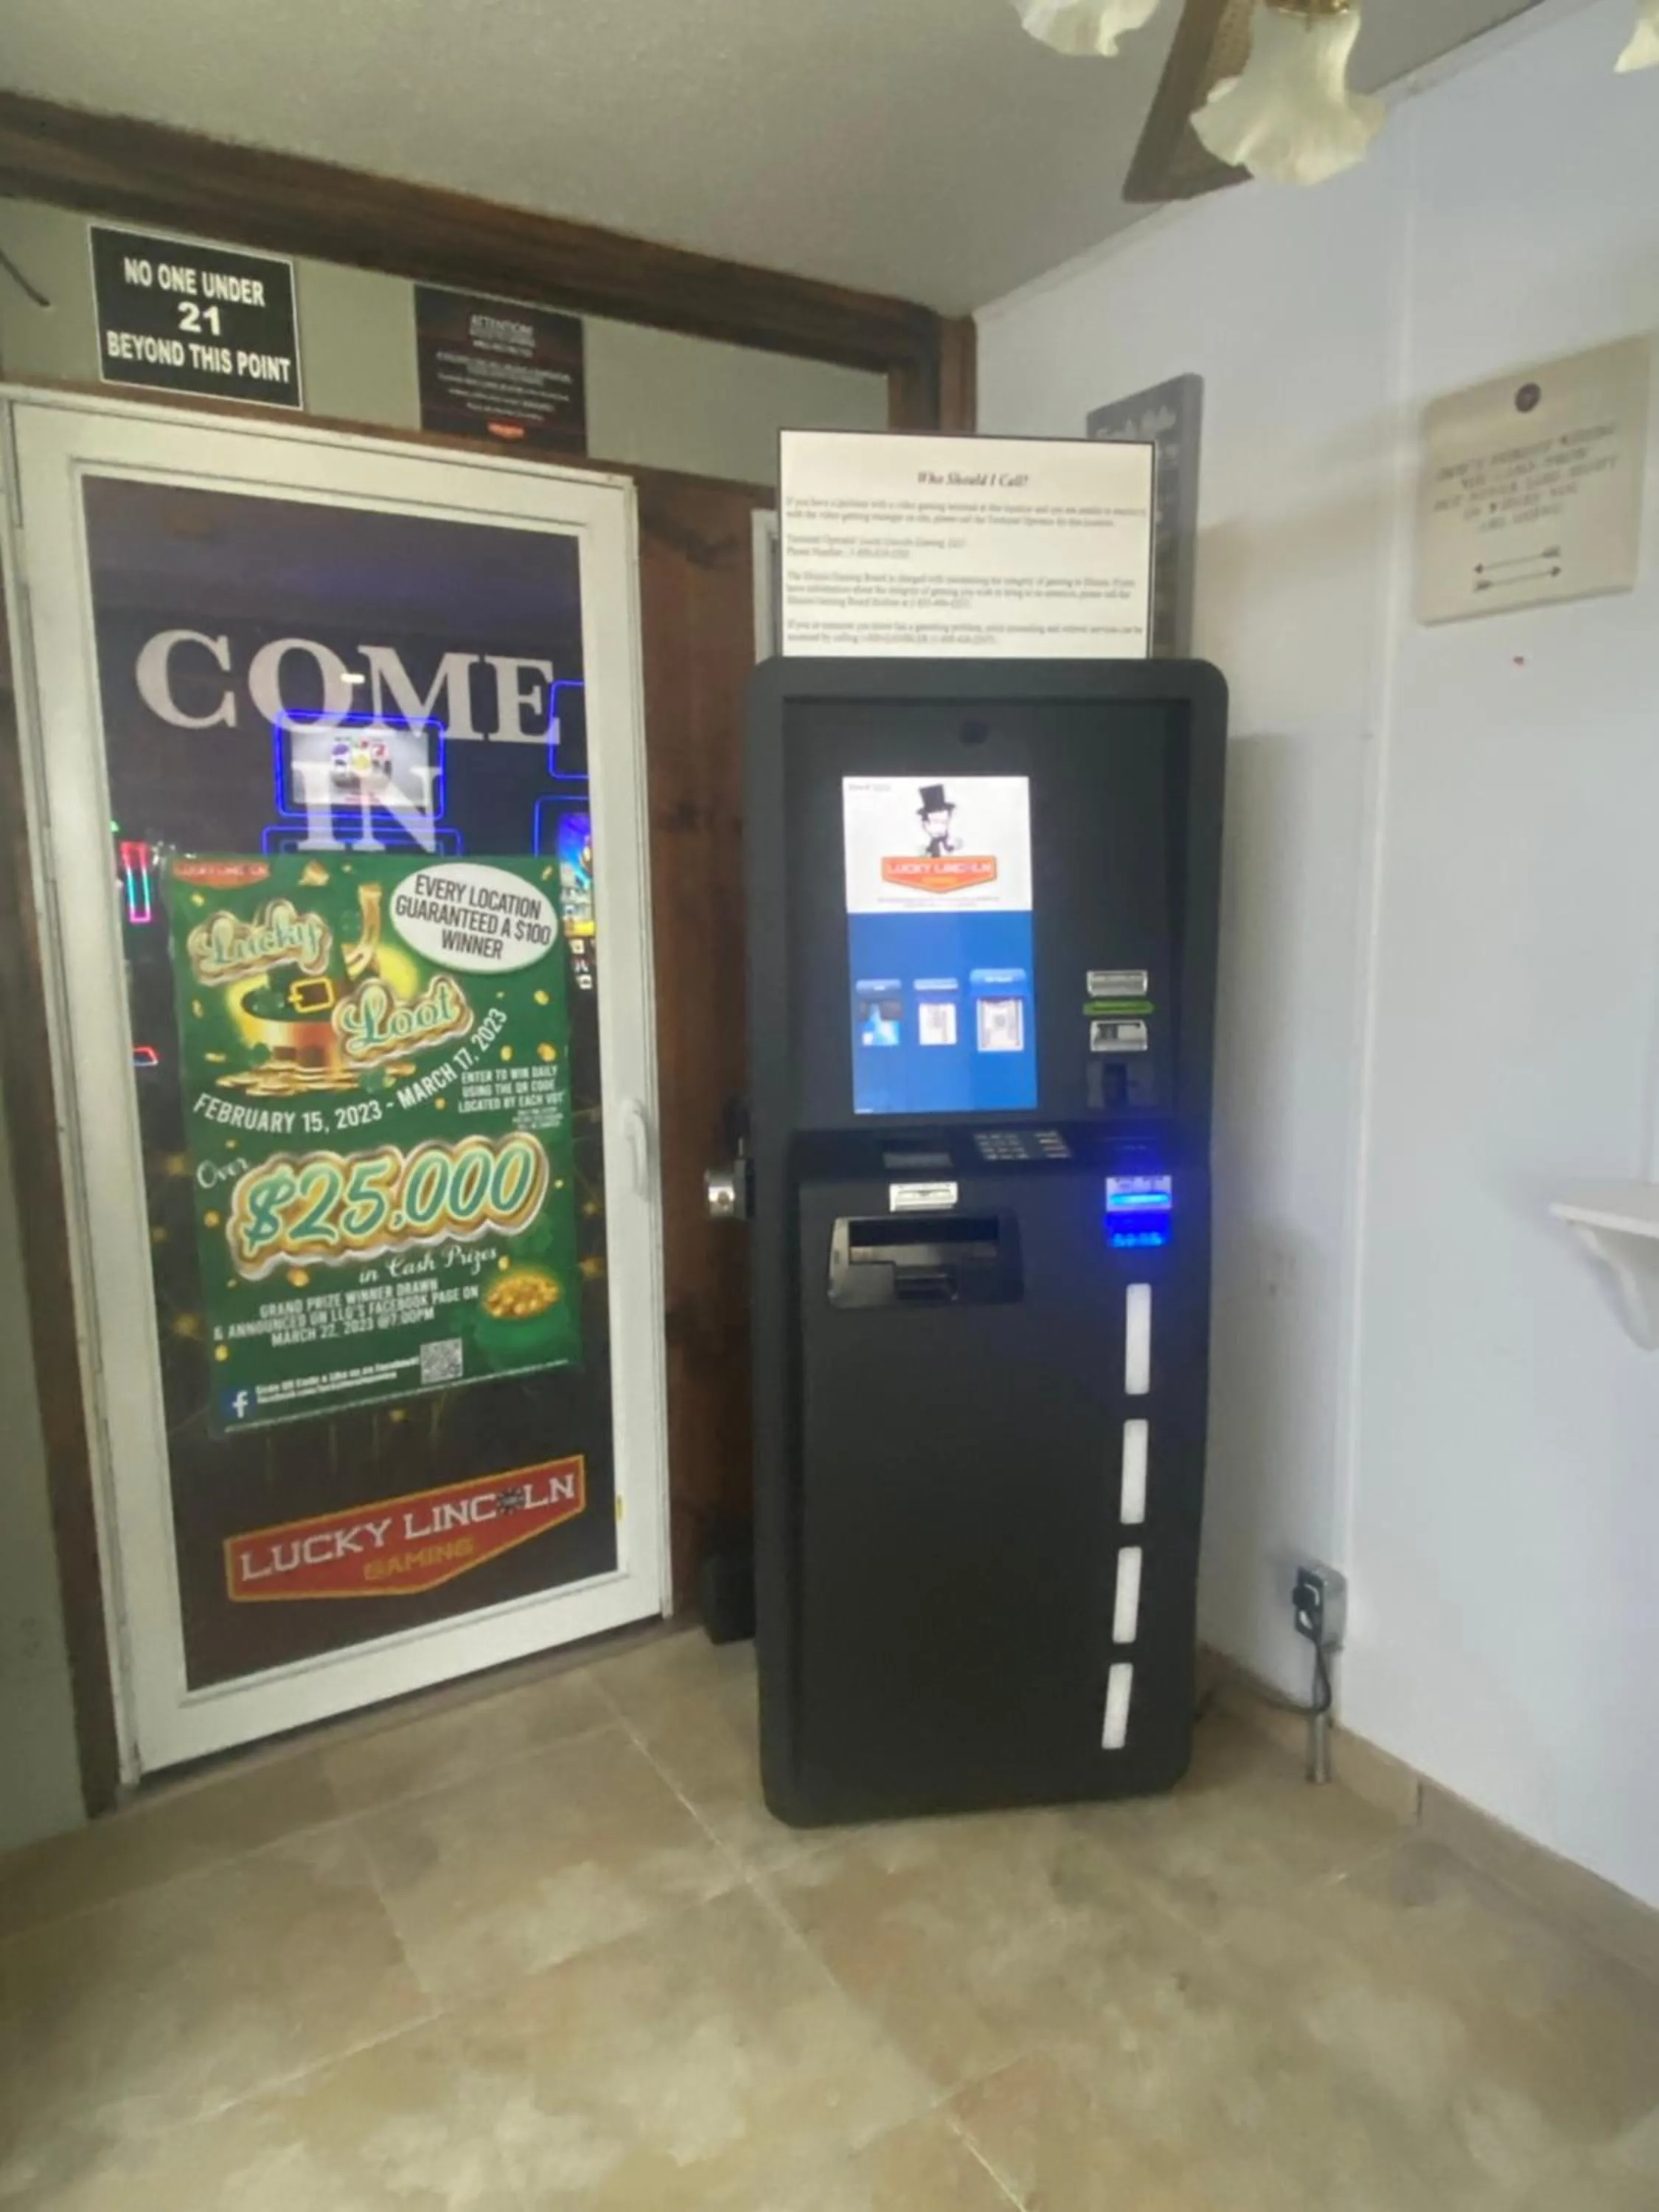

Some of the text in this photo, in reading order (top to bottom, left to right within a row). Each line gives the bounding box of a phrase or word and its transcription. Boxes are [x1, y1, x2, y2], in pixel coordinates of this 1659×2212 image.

[124, 257, 265, 307] NO ONE UNDER
[178, 301, 221, 337] 21
[106, 330, 291, 383] BEYOND THIS POINT
[946, 472, 987, 487] Should
[135, 629, 561, 745] COME
[291, 760, 444, 853] IN
[414, 874, 542, 920] EVERY LOCATION
[189, 902, 330, 978] Lucky
[395, 895, 552, 946] GUARANTEED A $100
[442, 930, 504, 960] WINNER
[336, 979, 466, 1062] Loot
[193, 1093, 296, 1133] FEBRUARY
[302, 1111, 330, 1134] 15,
[335, 1099, 383, 1130] 2023
[396, 1062, 458, 1110] MARCH
[453, 1047, 481, 1071] 17,
[471, 1007, 508, 1053] 2023
[495, 1068, 509, 1082] TO
[509, 1066, 530, 1080] WIN
[495, 1082, 512, 1095] THE
[196, 1158, 251, 1189] Over
[240, 1139, 542, 1259] $25,000
[358, 1243, 498, 1284] in Cash Prizes
[306, 1292, 342, 1312] PRIZE
[345, 1284, 393, 1304] WINNER
[395, 1278, 439, 1298] DRAWN
[369, 1295, 428, 1315] FACEBOOK
[431, 1287, 460, 1304] PAGE
[462, 1285, 479, 1301] ON
[271, 1326, 317, 1348] MARCH
[240, 1517, 393, 1582] LUCKY
[364, 1537, 476, 1582] GAMING
